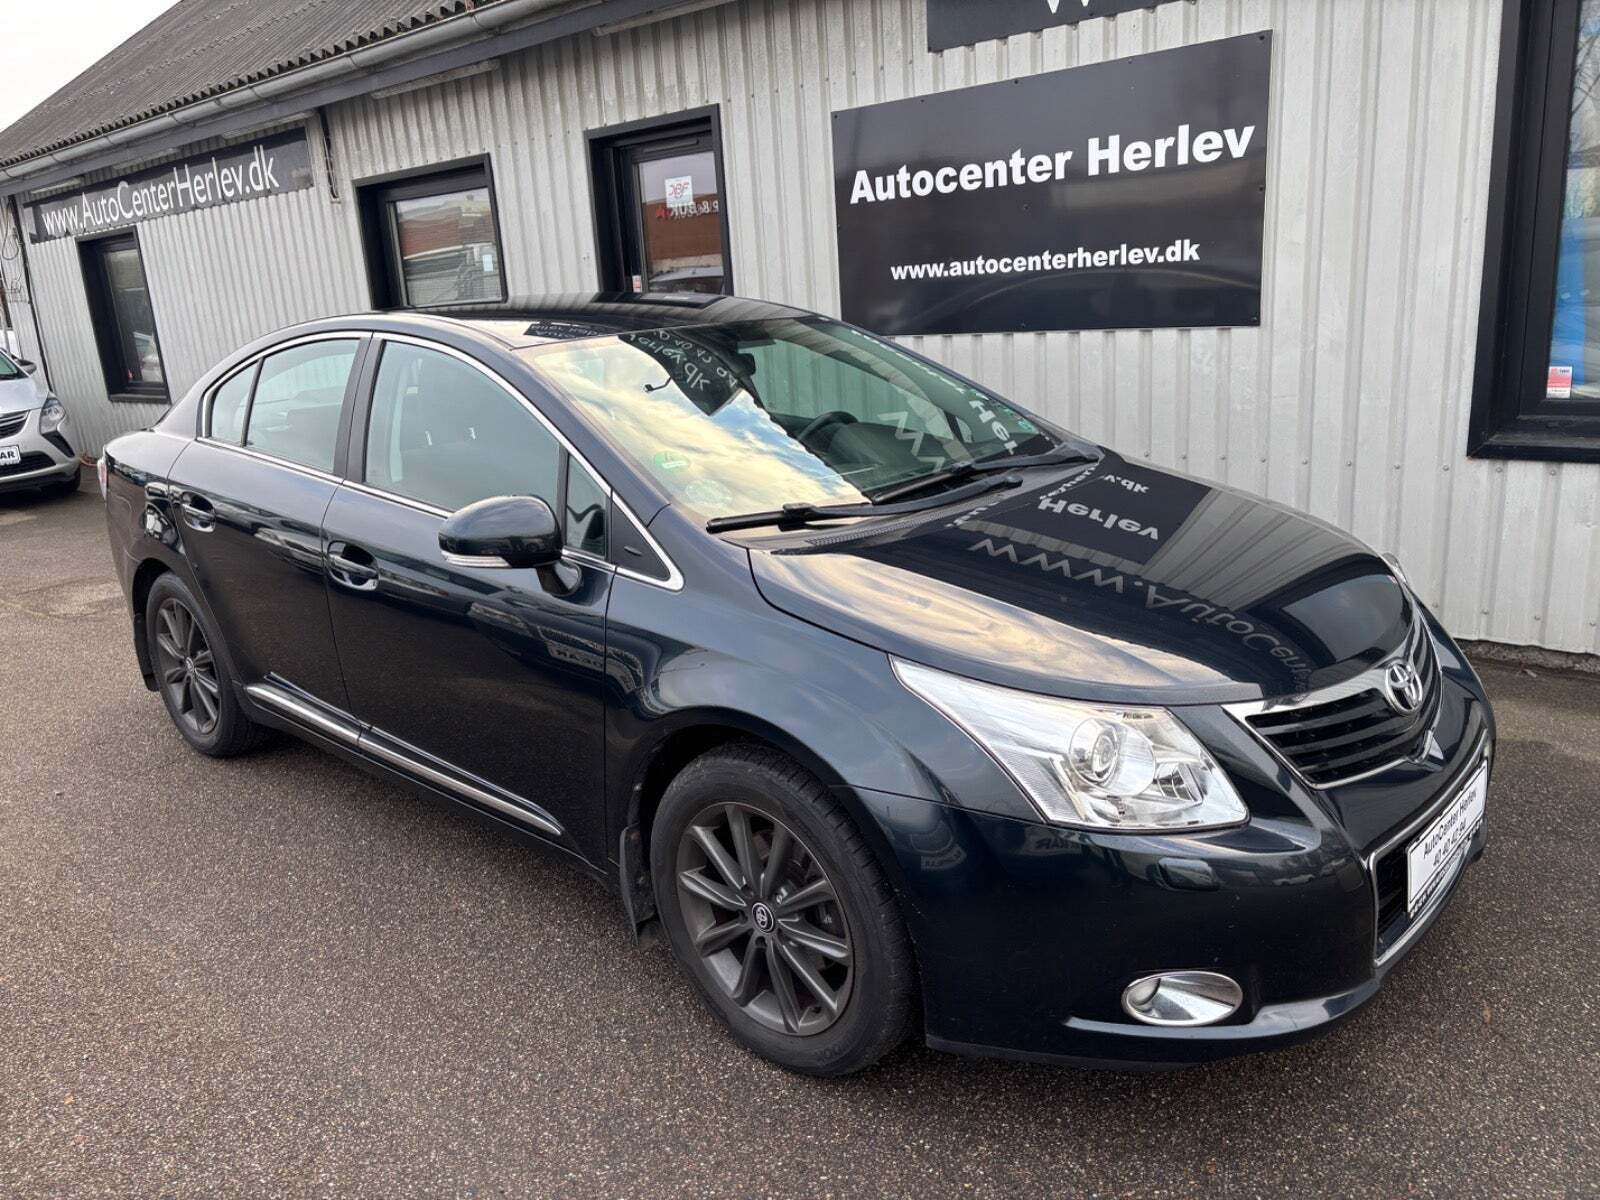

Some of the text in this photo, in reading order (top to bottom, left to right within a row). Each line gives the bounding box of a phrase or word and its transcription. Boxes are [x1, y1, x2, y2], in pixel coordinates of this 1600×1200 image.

[41, 145, 280, 234] www.AutoCenterHerlev.dk
[850, 124, 1256, 204] Autocenter Herlev
[890, 238, 1201, 281] www.autocenterherlev.dk
